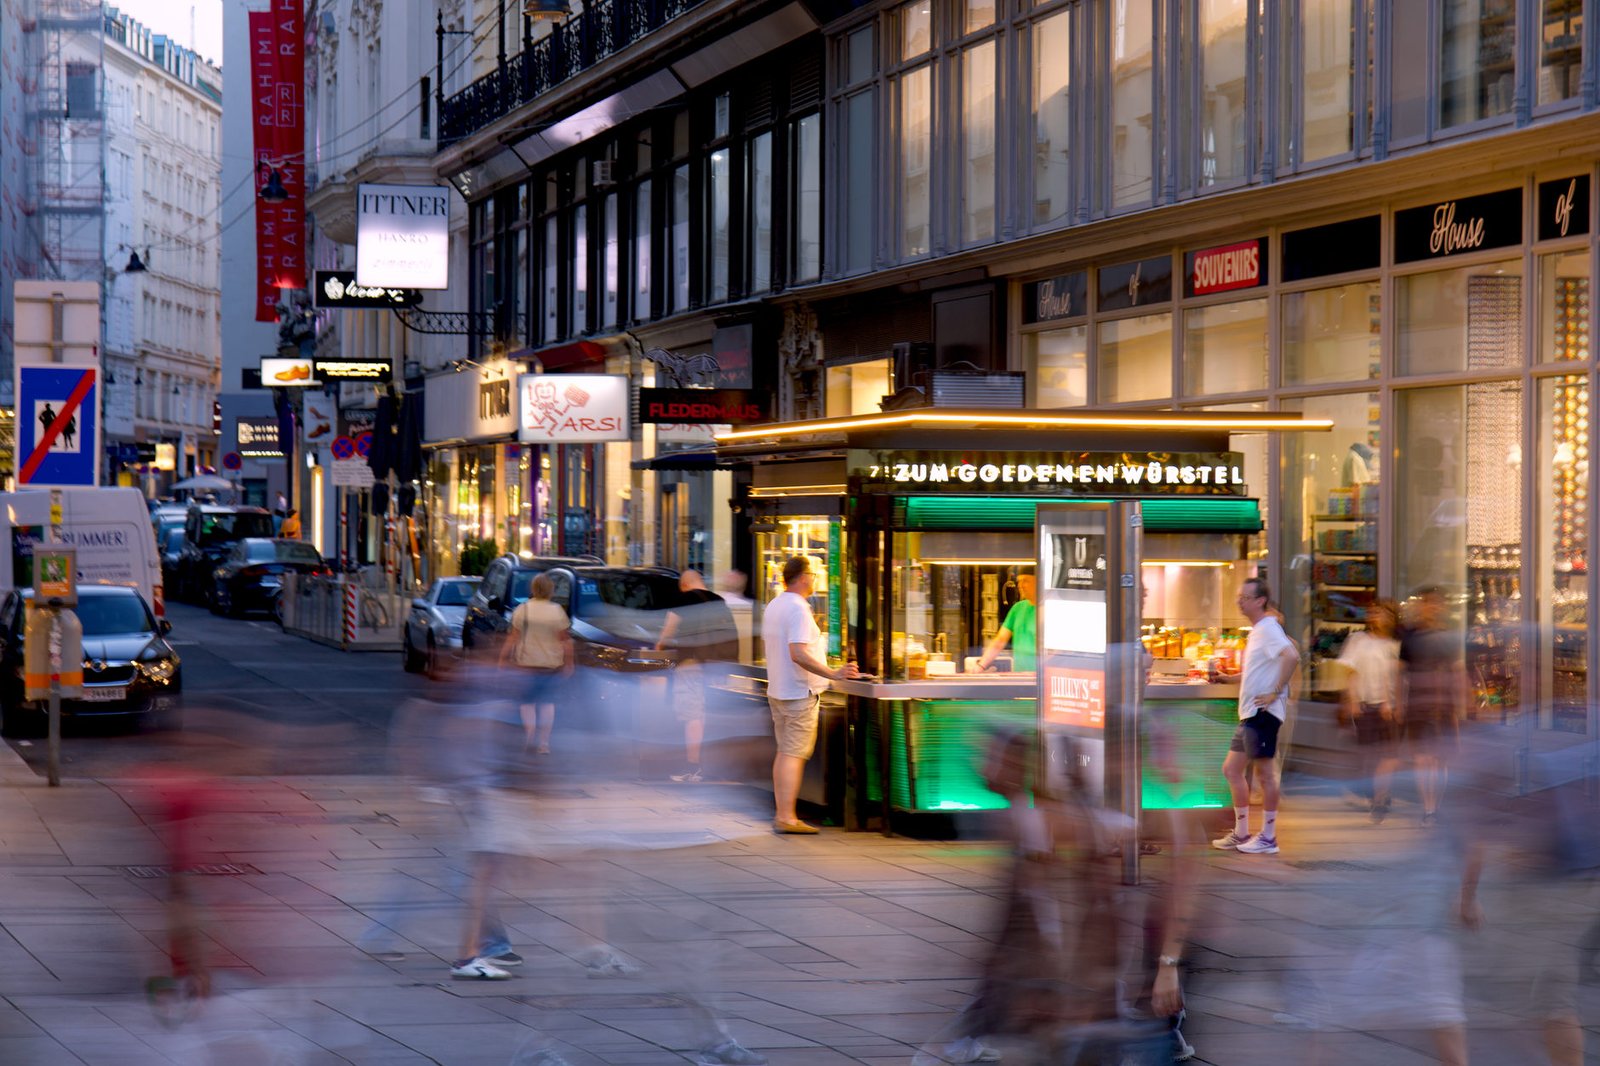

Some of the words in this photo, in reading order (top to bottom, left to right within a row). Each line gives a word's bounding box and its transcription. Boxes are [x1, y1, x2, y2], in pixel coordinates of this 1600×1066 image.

[258, 27, 273, 126] RAHIMI
[361, 193, 447, 217] ITTNER
[1430, 202, 1485, 255] House
[1555, 178, 1576, 237] of
[1039, 280, 1071, 319] House
[1128, 262, 1142, 306] of
[1194, 246, 1259, 289] SOUVENIRS
[648, 402, 761, 420] FLEDERMAUS
[894, 463, 950, 484] ZUM
[957, 463, 1116, 484] GOLDENEN
[1121, 461, 1244, 485] WÜRSTEL
